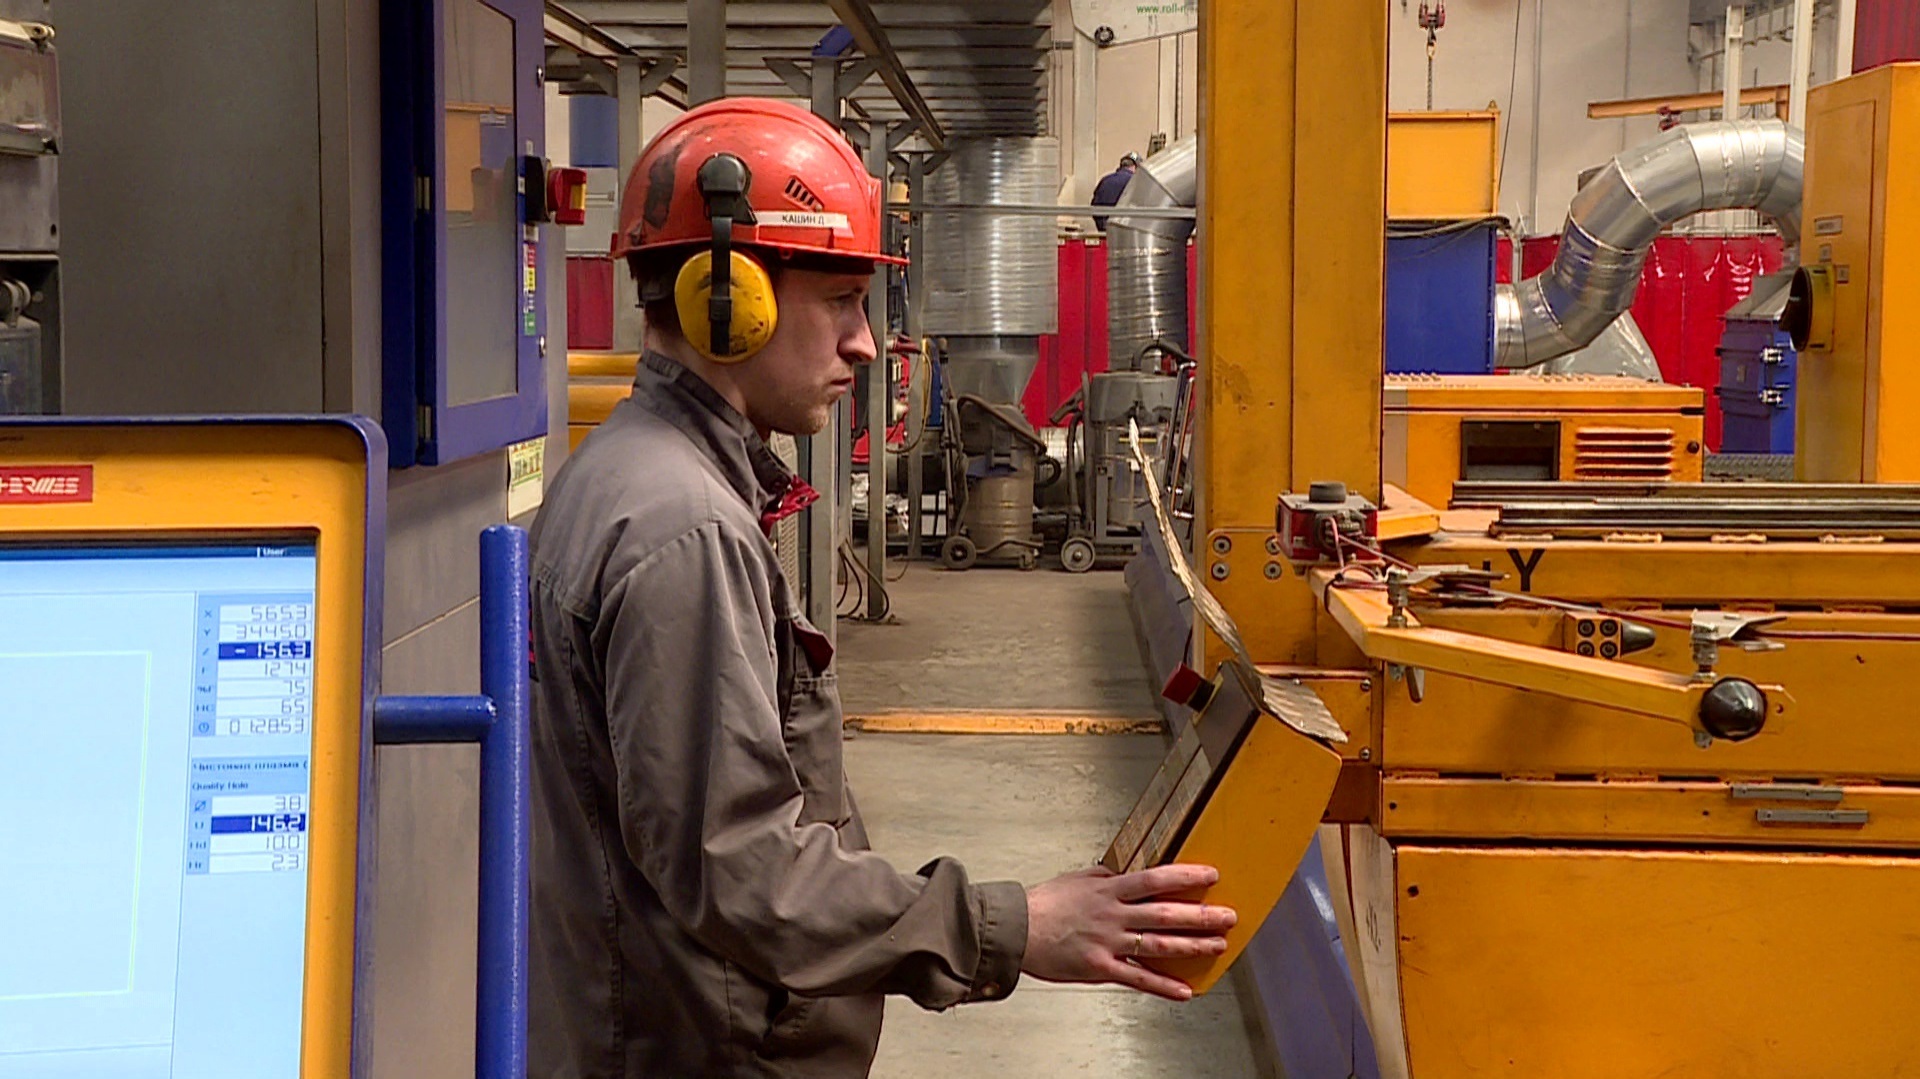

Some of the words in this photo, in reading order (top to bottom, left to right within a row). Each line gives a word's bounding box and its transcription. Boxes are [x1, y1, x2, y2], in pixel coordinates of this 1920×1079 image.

[782, 214, 816, 225] КАШИН
[1506, 548, 1546, 592] Y
[284, 680, 305, 696] 75
[281, 698, 305, 714] 65
